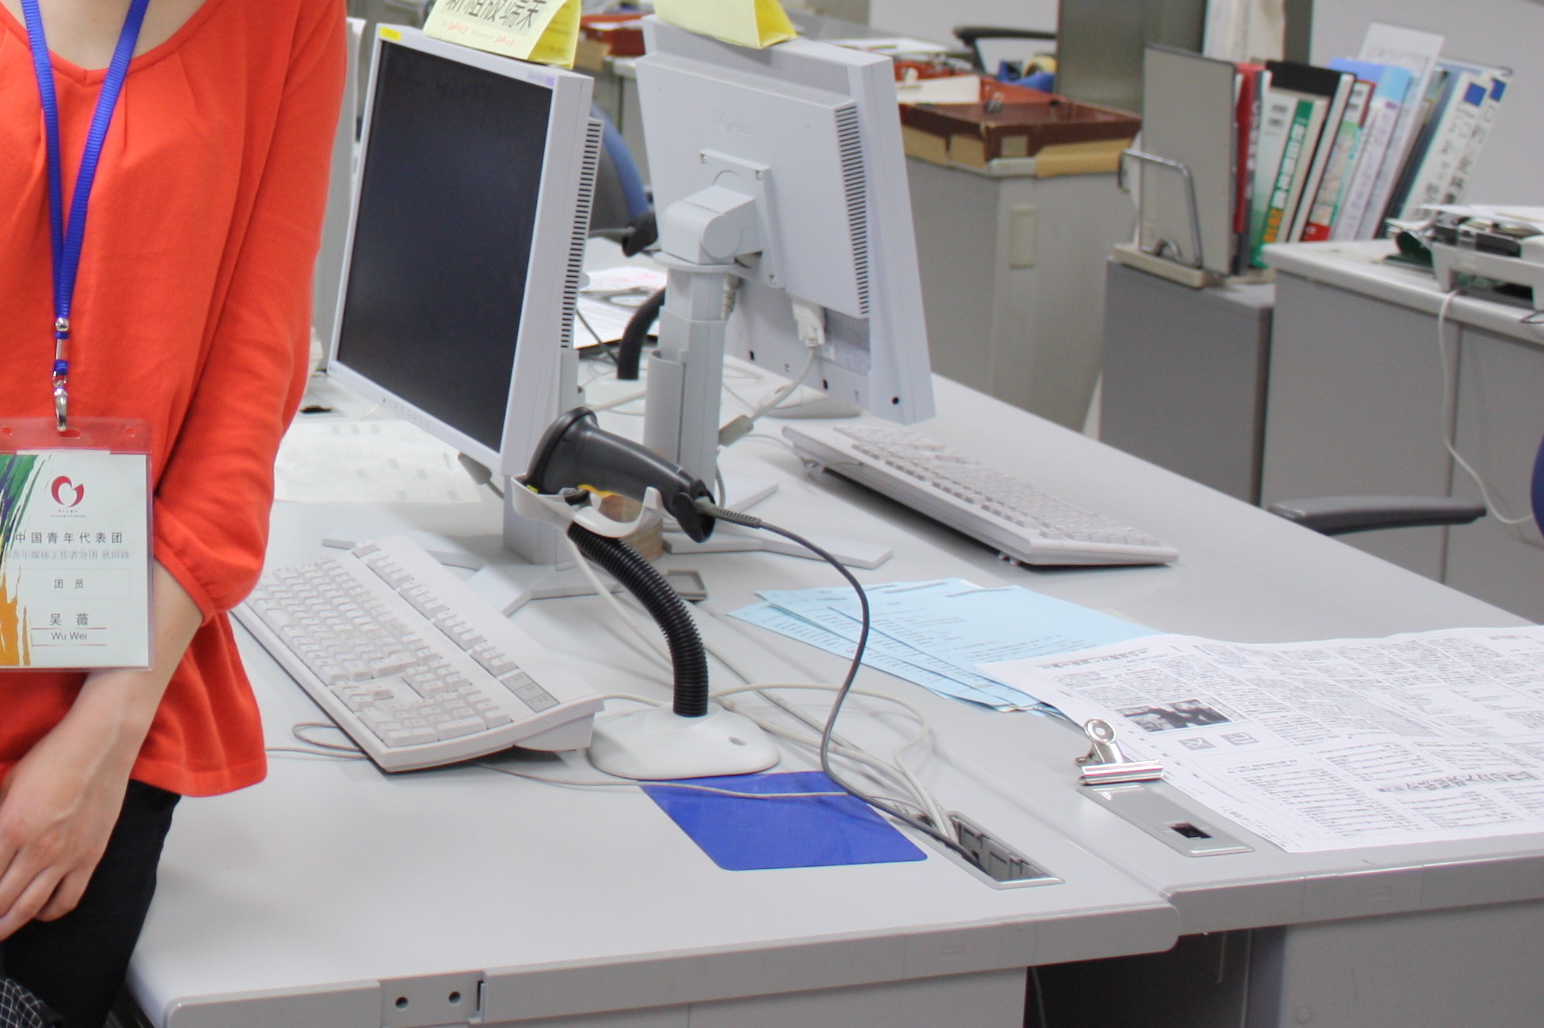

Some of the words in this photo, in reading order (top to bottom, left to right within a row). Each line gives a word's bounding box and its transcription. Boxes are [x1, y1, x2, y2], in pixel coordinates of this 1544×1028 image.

[15, 531, 123, 544] 中国青年代表团
[51, 631, 67, 641] Wu
[69, 630, 88, 641] Wei
